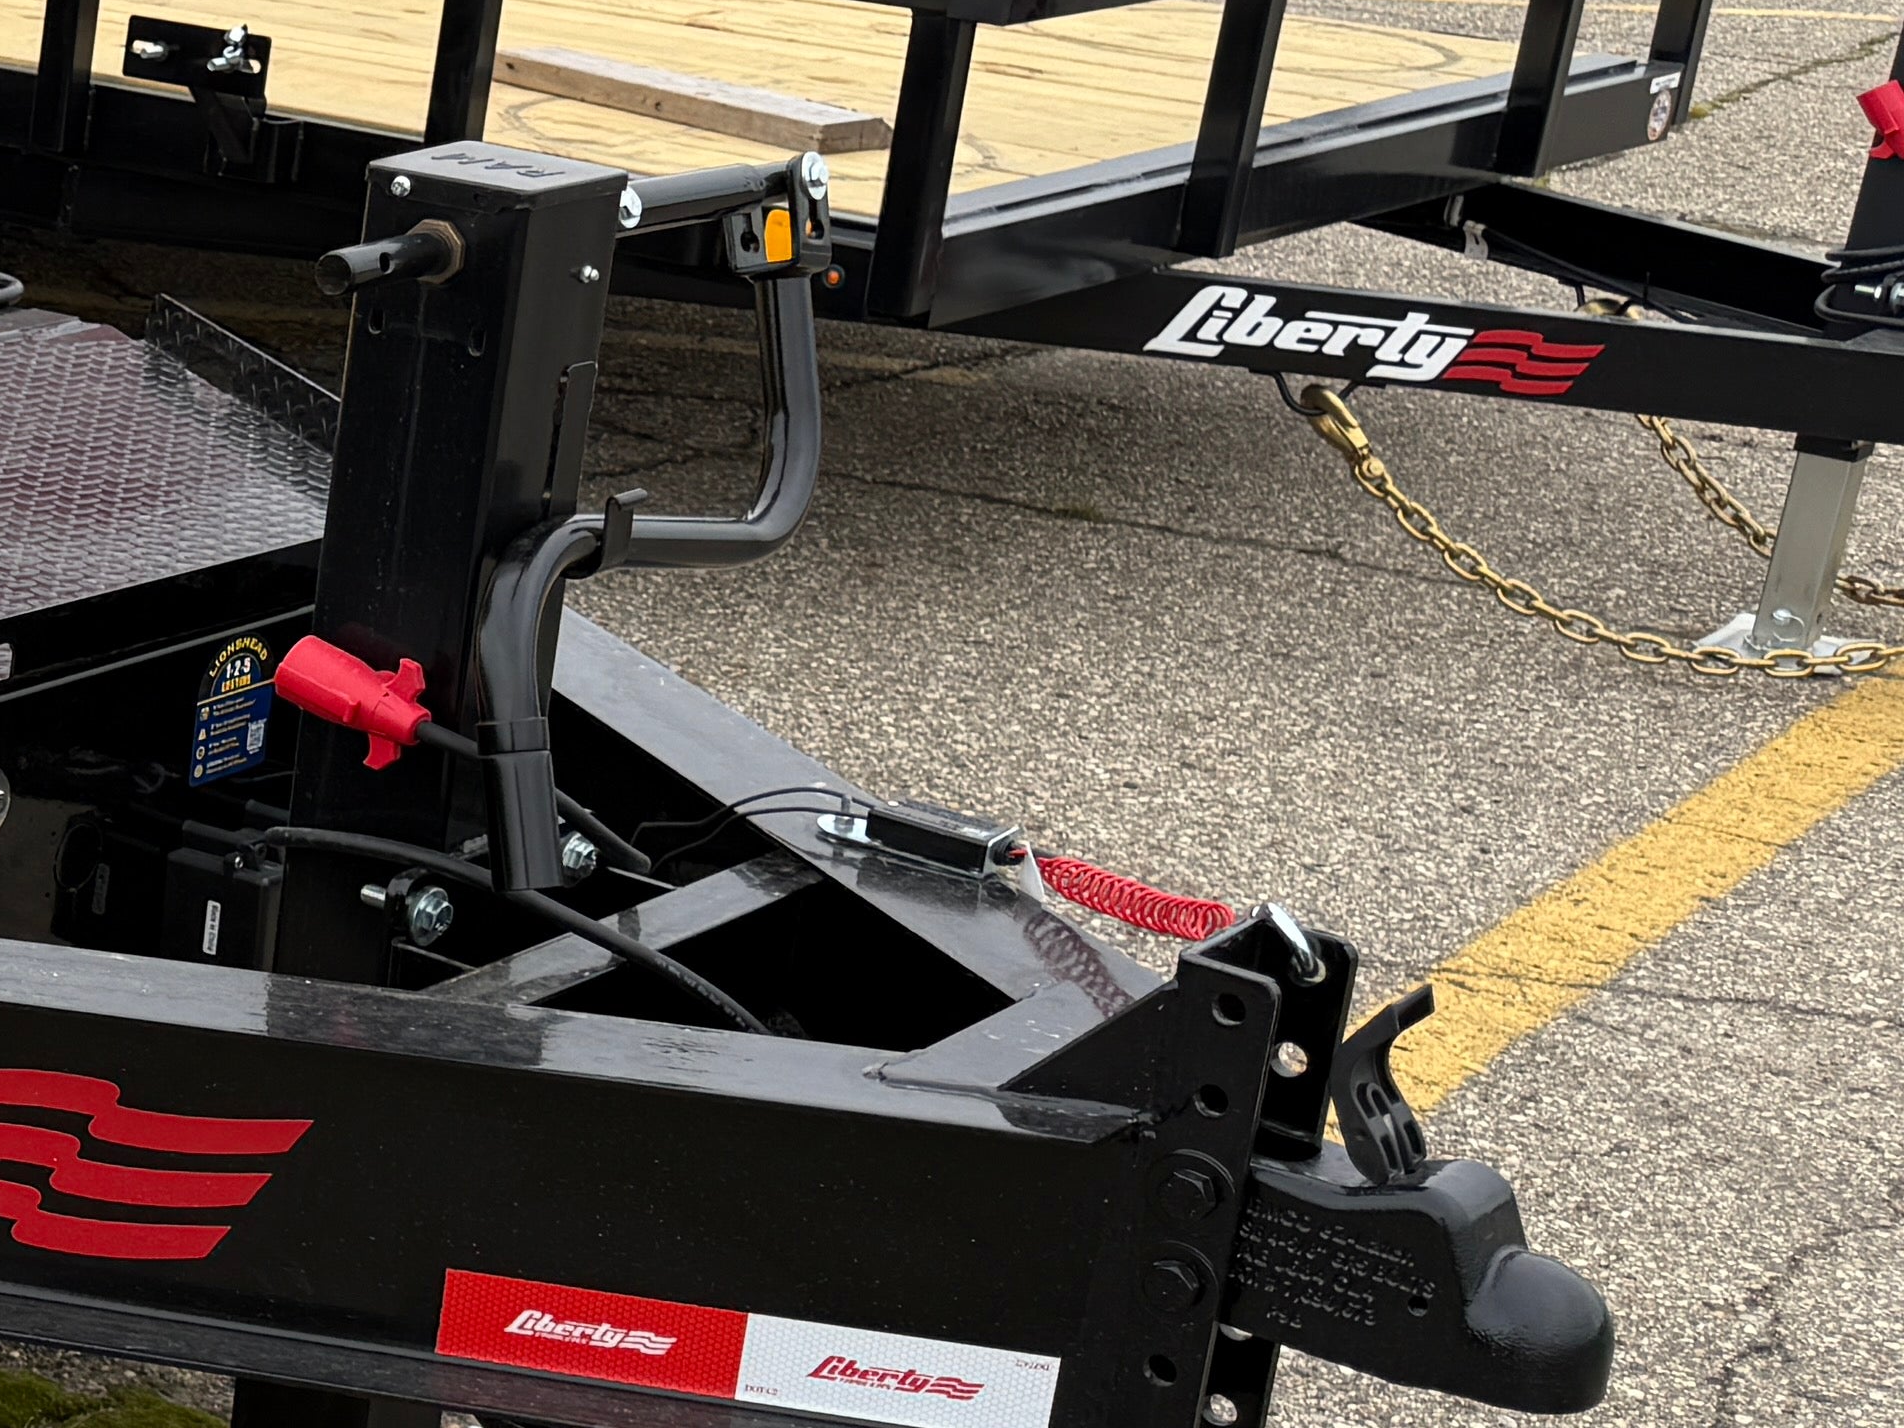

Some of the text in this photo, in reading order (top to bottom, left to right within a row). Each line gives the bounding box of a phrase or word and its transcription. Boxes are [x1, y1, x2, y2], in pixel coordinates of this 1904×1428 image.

[1143, 284, 1474, 383] Liberty
[208, 636, 268, 679] LIONSHEAD
[504, 1308, 628, 1349] Liberty
[806, 1355, 934, 1394] Liberty
